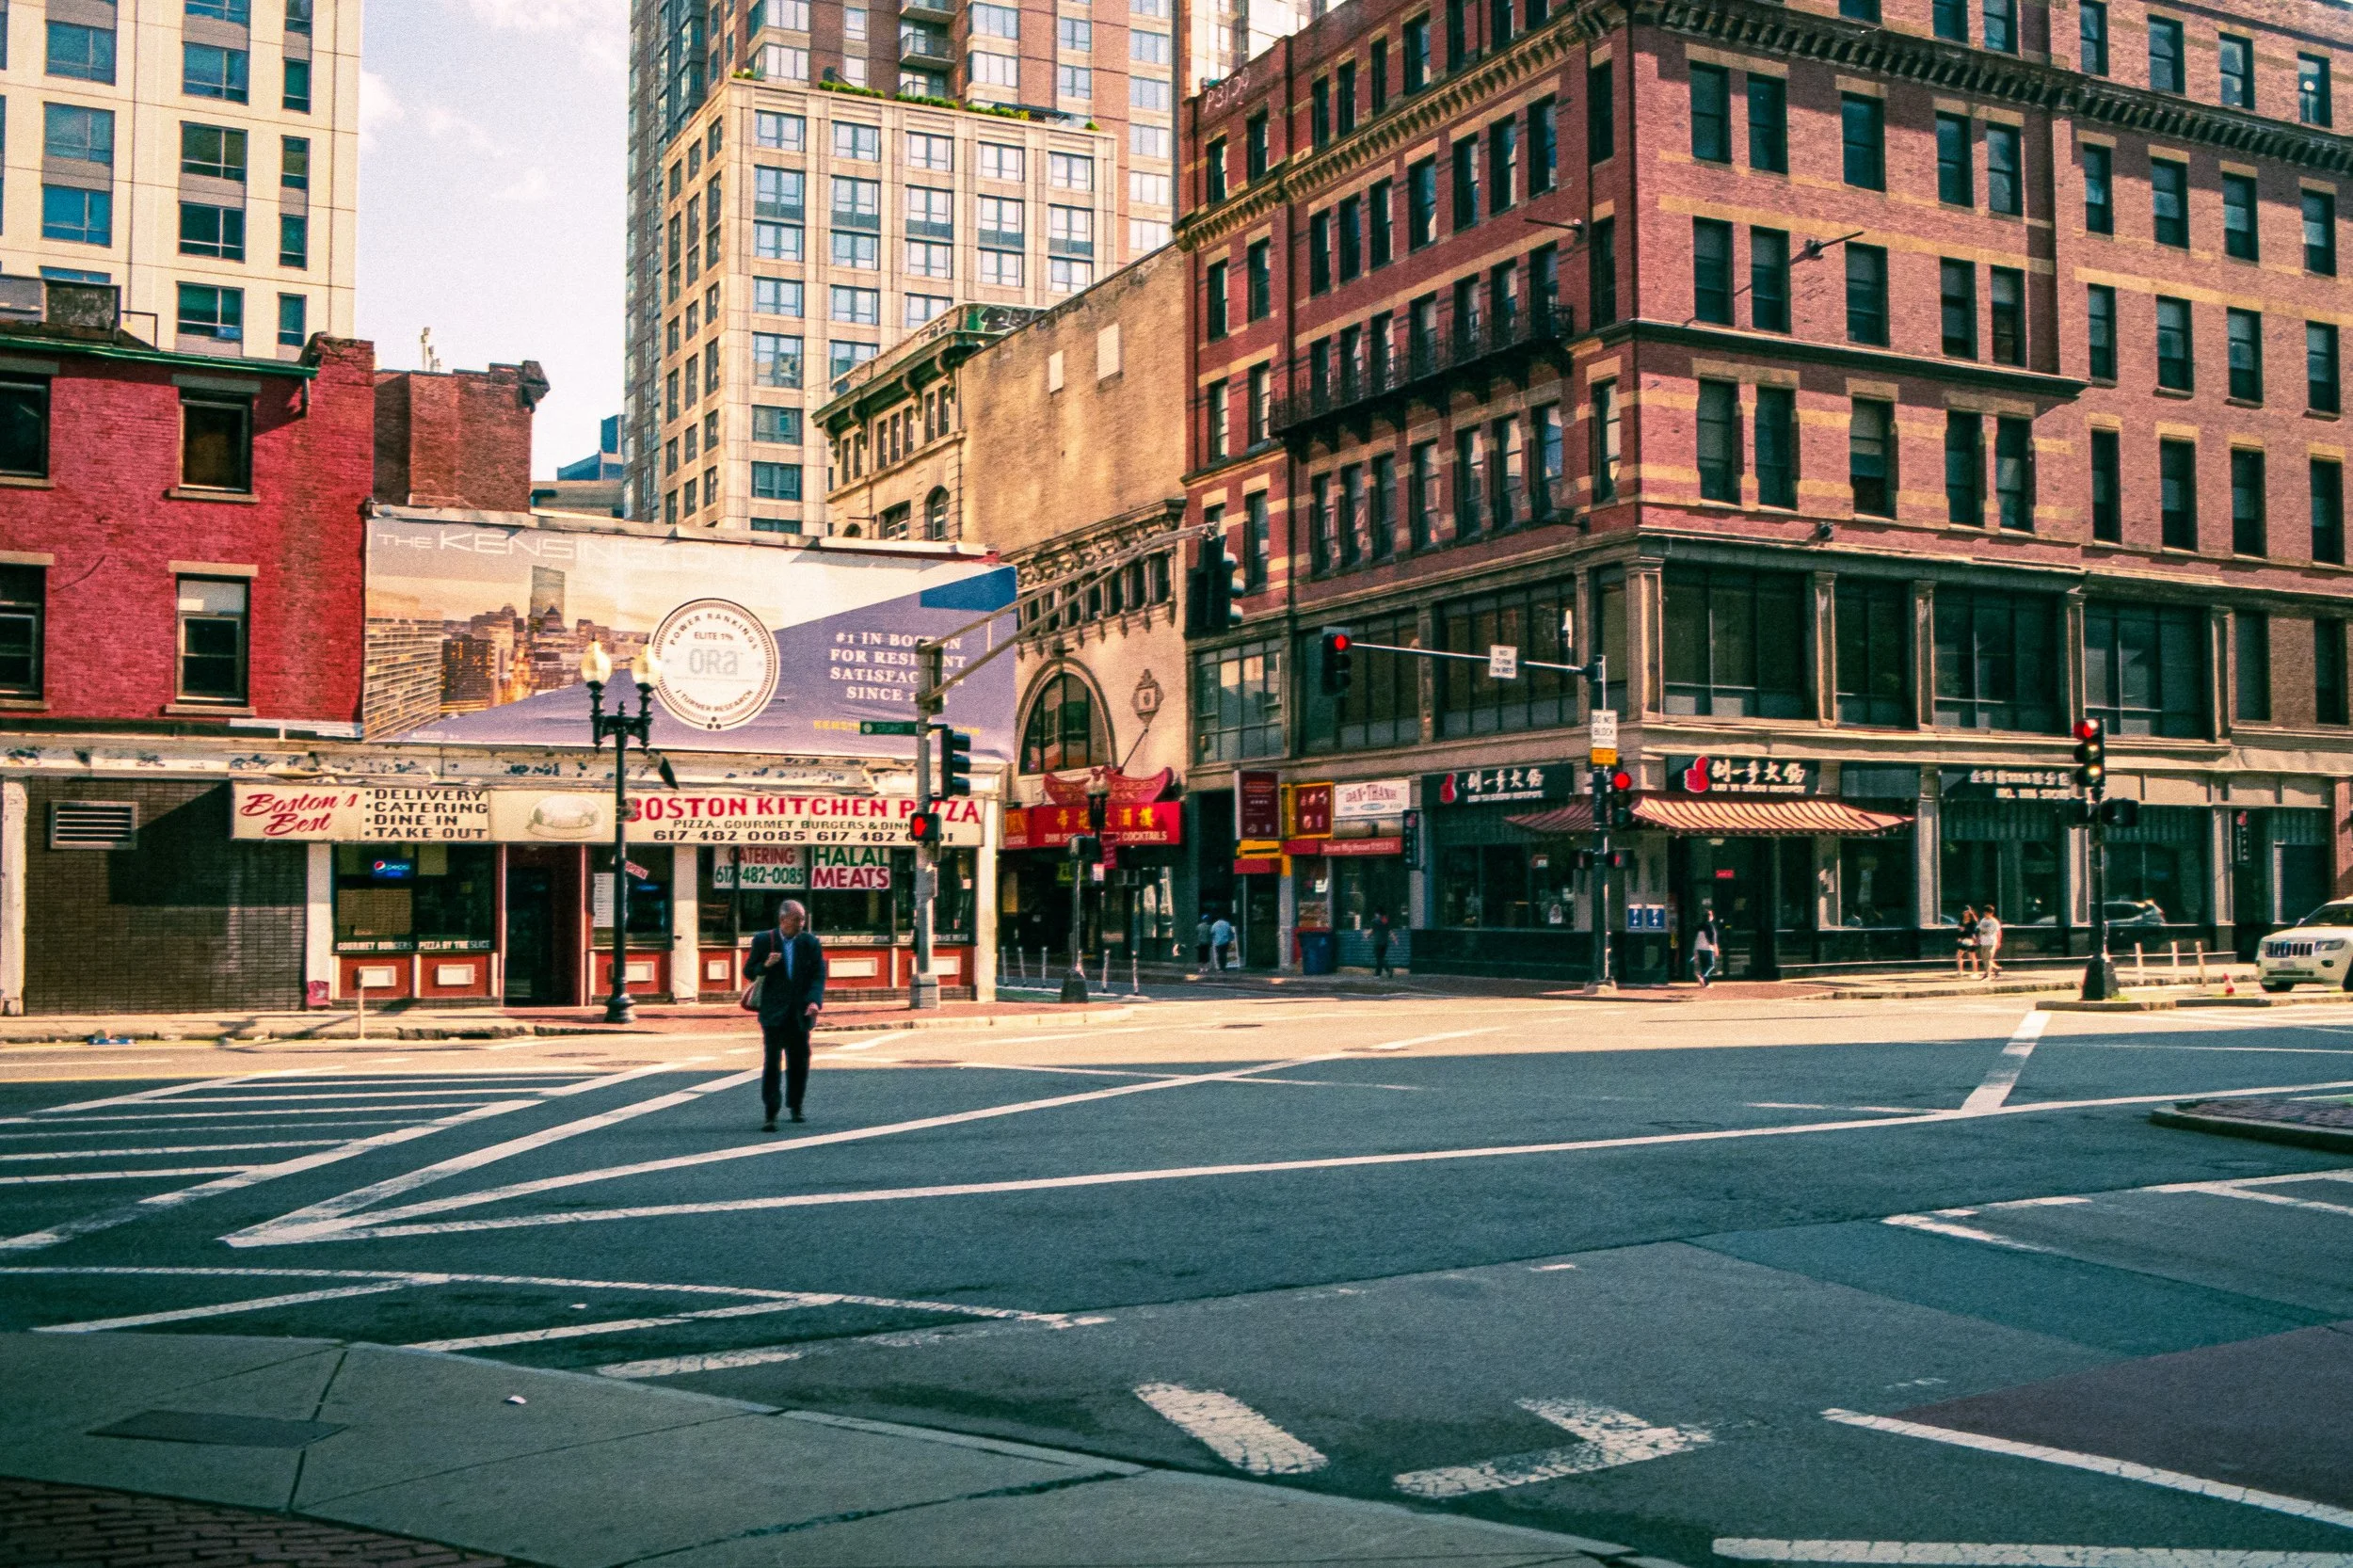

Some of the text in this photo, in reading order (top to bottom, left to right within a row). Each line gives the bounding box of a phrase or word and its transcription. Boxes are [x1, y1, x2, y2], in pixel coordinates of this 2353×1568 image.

[376, 534, 432, 550] THE
[669, 613, 758, 649] POWER RANKINGS
[694, 632, 717, 640] ELITE
[835, 632, 855, 644] #1
[861, 632, 882, 645] IN
[829, 648, 967, 669] FOR RESINT
[680, 694, 712, 712] TURNER
[713, 689, 753, 712] RESEARCH
[846, 686, 903, 701] SINCE
[375, 789, 483, 800] DELIVERY
[239, 791, 359, 816] Boston's
[375, 802, 488, 813] CATERING
[625, 797, 748, 823] BOSTON
[756, 797, 888, 817] KITCHEN
[264, 812, 332, 837] Best
[725, 820, 794, 829] GOURMET
[801, 821, 865, 829] BURGERS
[880, 822, 911, 830] DINN
[653, 830, 806, 840] 617-482-0085
[1122, 831, 1168, 841] COCKTAILS
[727, 847, 796, 865] CATERING
[813, 846, 889, 867] HALAL
[813, 868, 889, 888] MEATS
[419, 941, 441, 950] PIZZA
[470, 940, 490, 949] SLICE
